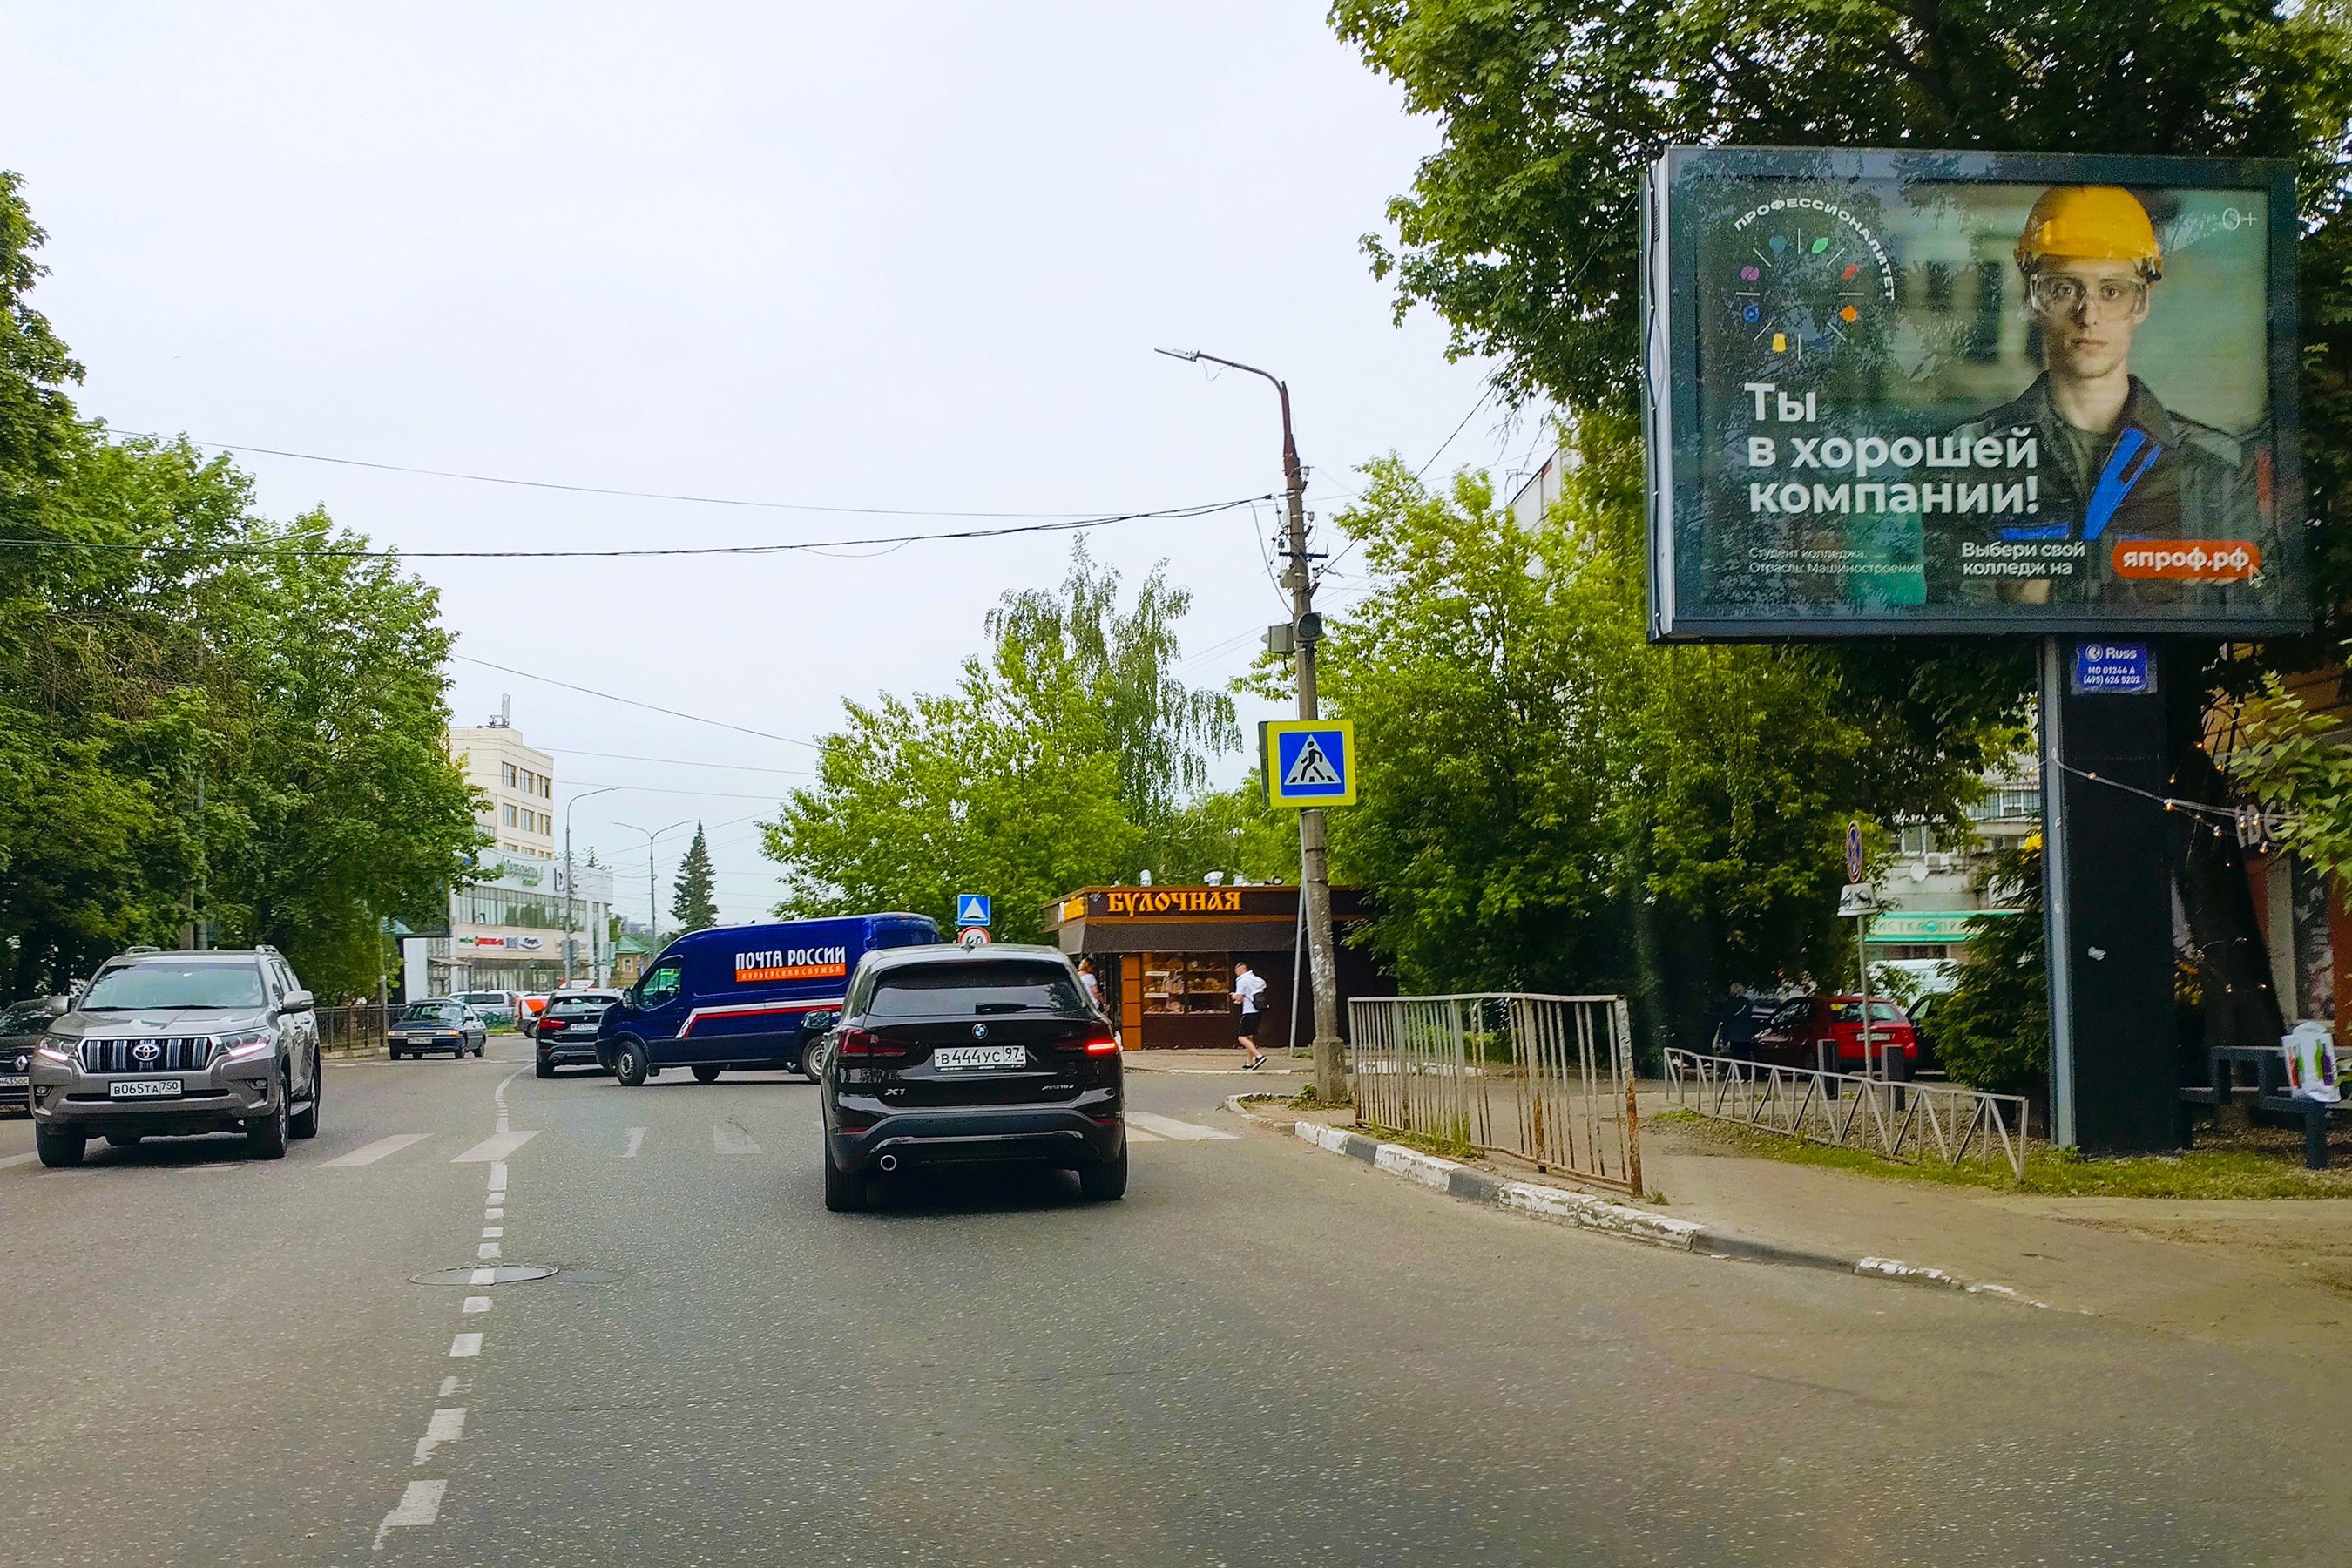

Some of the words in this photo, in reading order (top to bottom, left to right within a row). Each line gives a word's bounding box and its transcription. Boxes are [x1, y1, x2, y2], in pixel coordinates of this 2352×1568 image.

[2222, 207, 2257, 231] 0+
[1734, 198, 1896, 301] ПРОФЕССИОНАЛИТЕТ
[1744, 382, 1816, 422] Ты
[1748, 437, 1775, 468] в
[1790, 427, 2038, 478] хорошей
[1749, 476, 2040, 515] компании!
[1748, 547, 1799, 561] Студент
[1962, 541, 2038, 562] Выбери
[2041, 540, 2085, 558] свой
[2123, 546, 2250, 572] япроф.рф
[1808, 562, 1924, 575] Машиностроение
[1963, 562, 2046, 578] колледж
[2050, 563, 2073, 575] на
[2105, 647, 2138, 659] Russ
[1107, 891, 1242, 917] БУЛОЧНАЯ
[735, 950, 783, 970] ПОЧТА
[787, 946, 846, 966] РОССИИ
